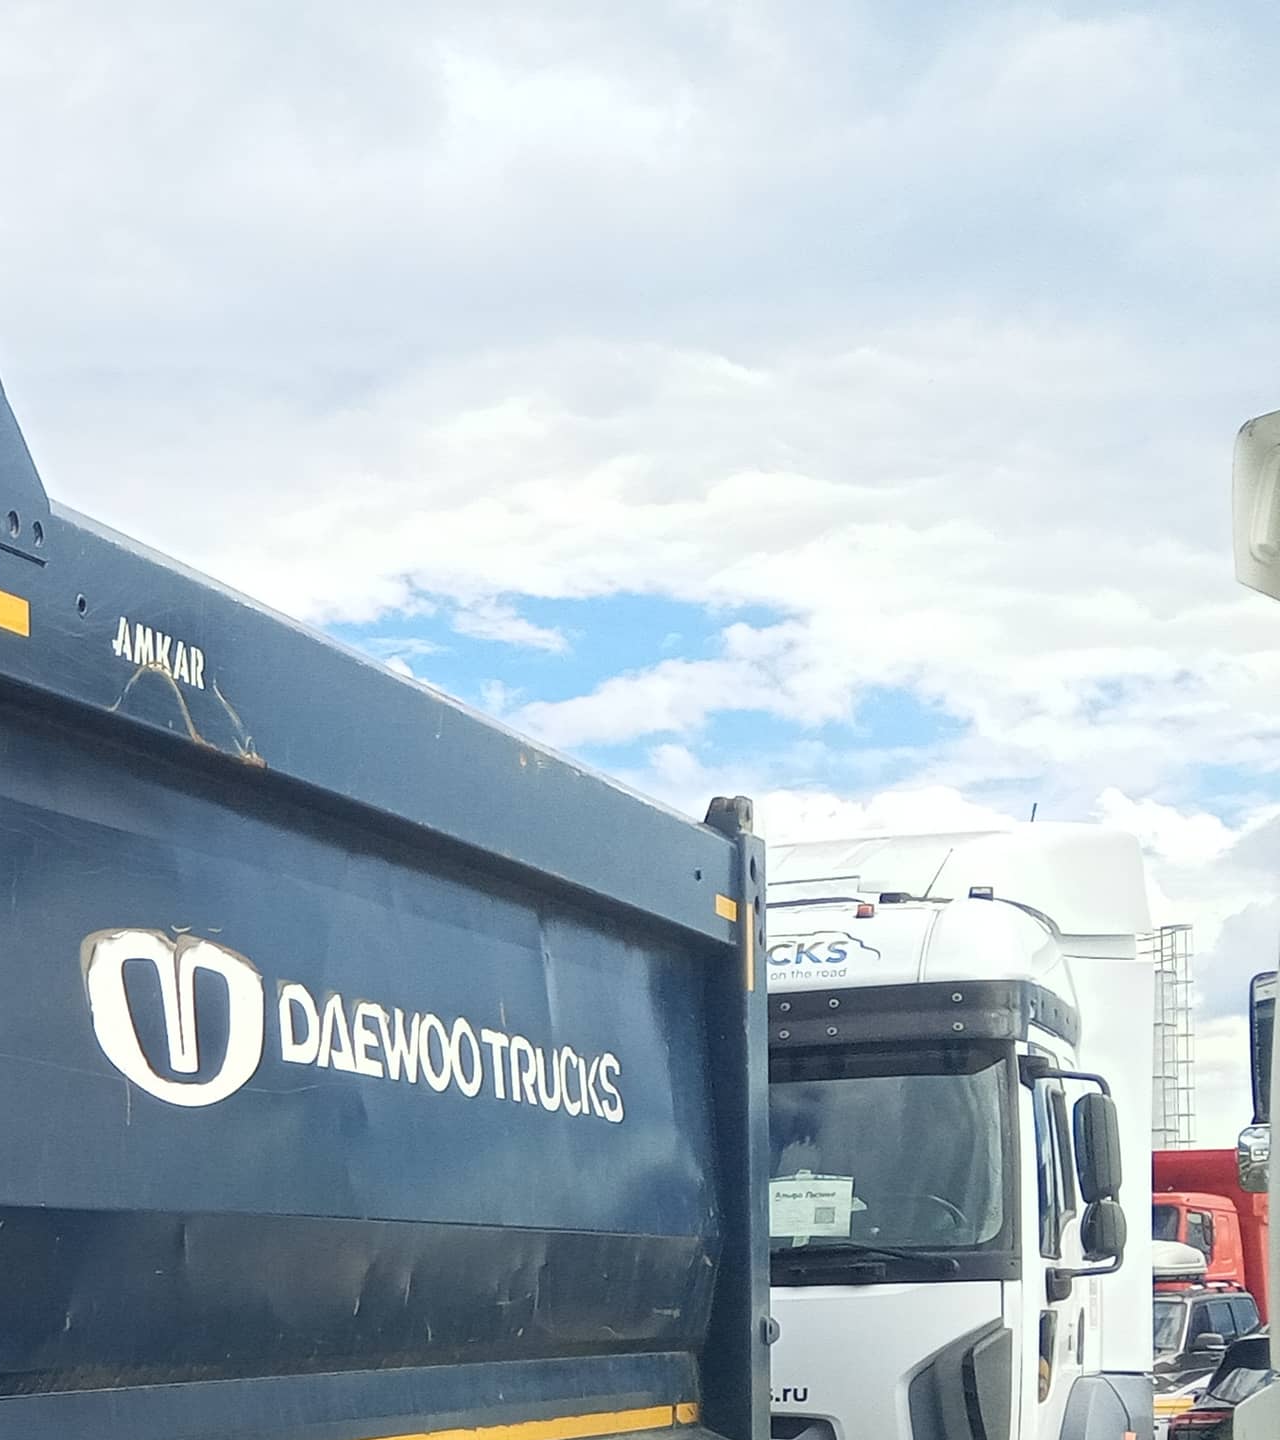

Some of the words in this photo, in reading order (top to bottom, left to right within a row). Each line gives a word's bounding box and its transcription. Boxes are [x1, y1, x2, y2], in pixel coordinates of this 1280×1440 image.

[112, 616, 205, 690] AMKAR
[770, 972, 786, 981] on
[791, 969, 812, 979] the
[816, 968, 848, 978] road
[278, 983, 483, 1098] DAEWOO
[481, 1028, 625, 1124] TRUCKS
[770, 1387, 809, 1402] .ru
